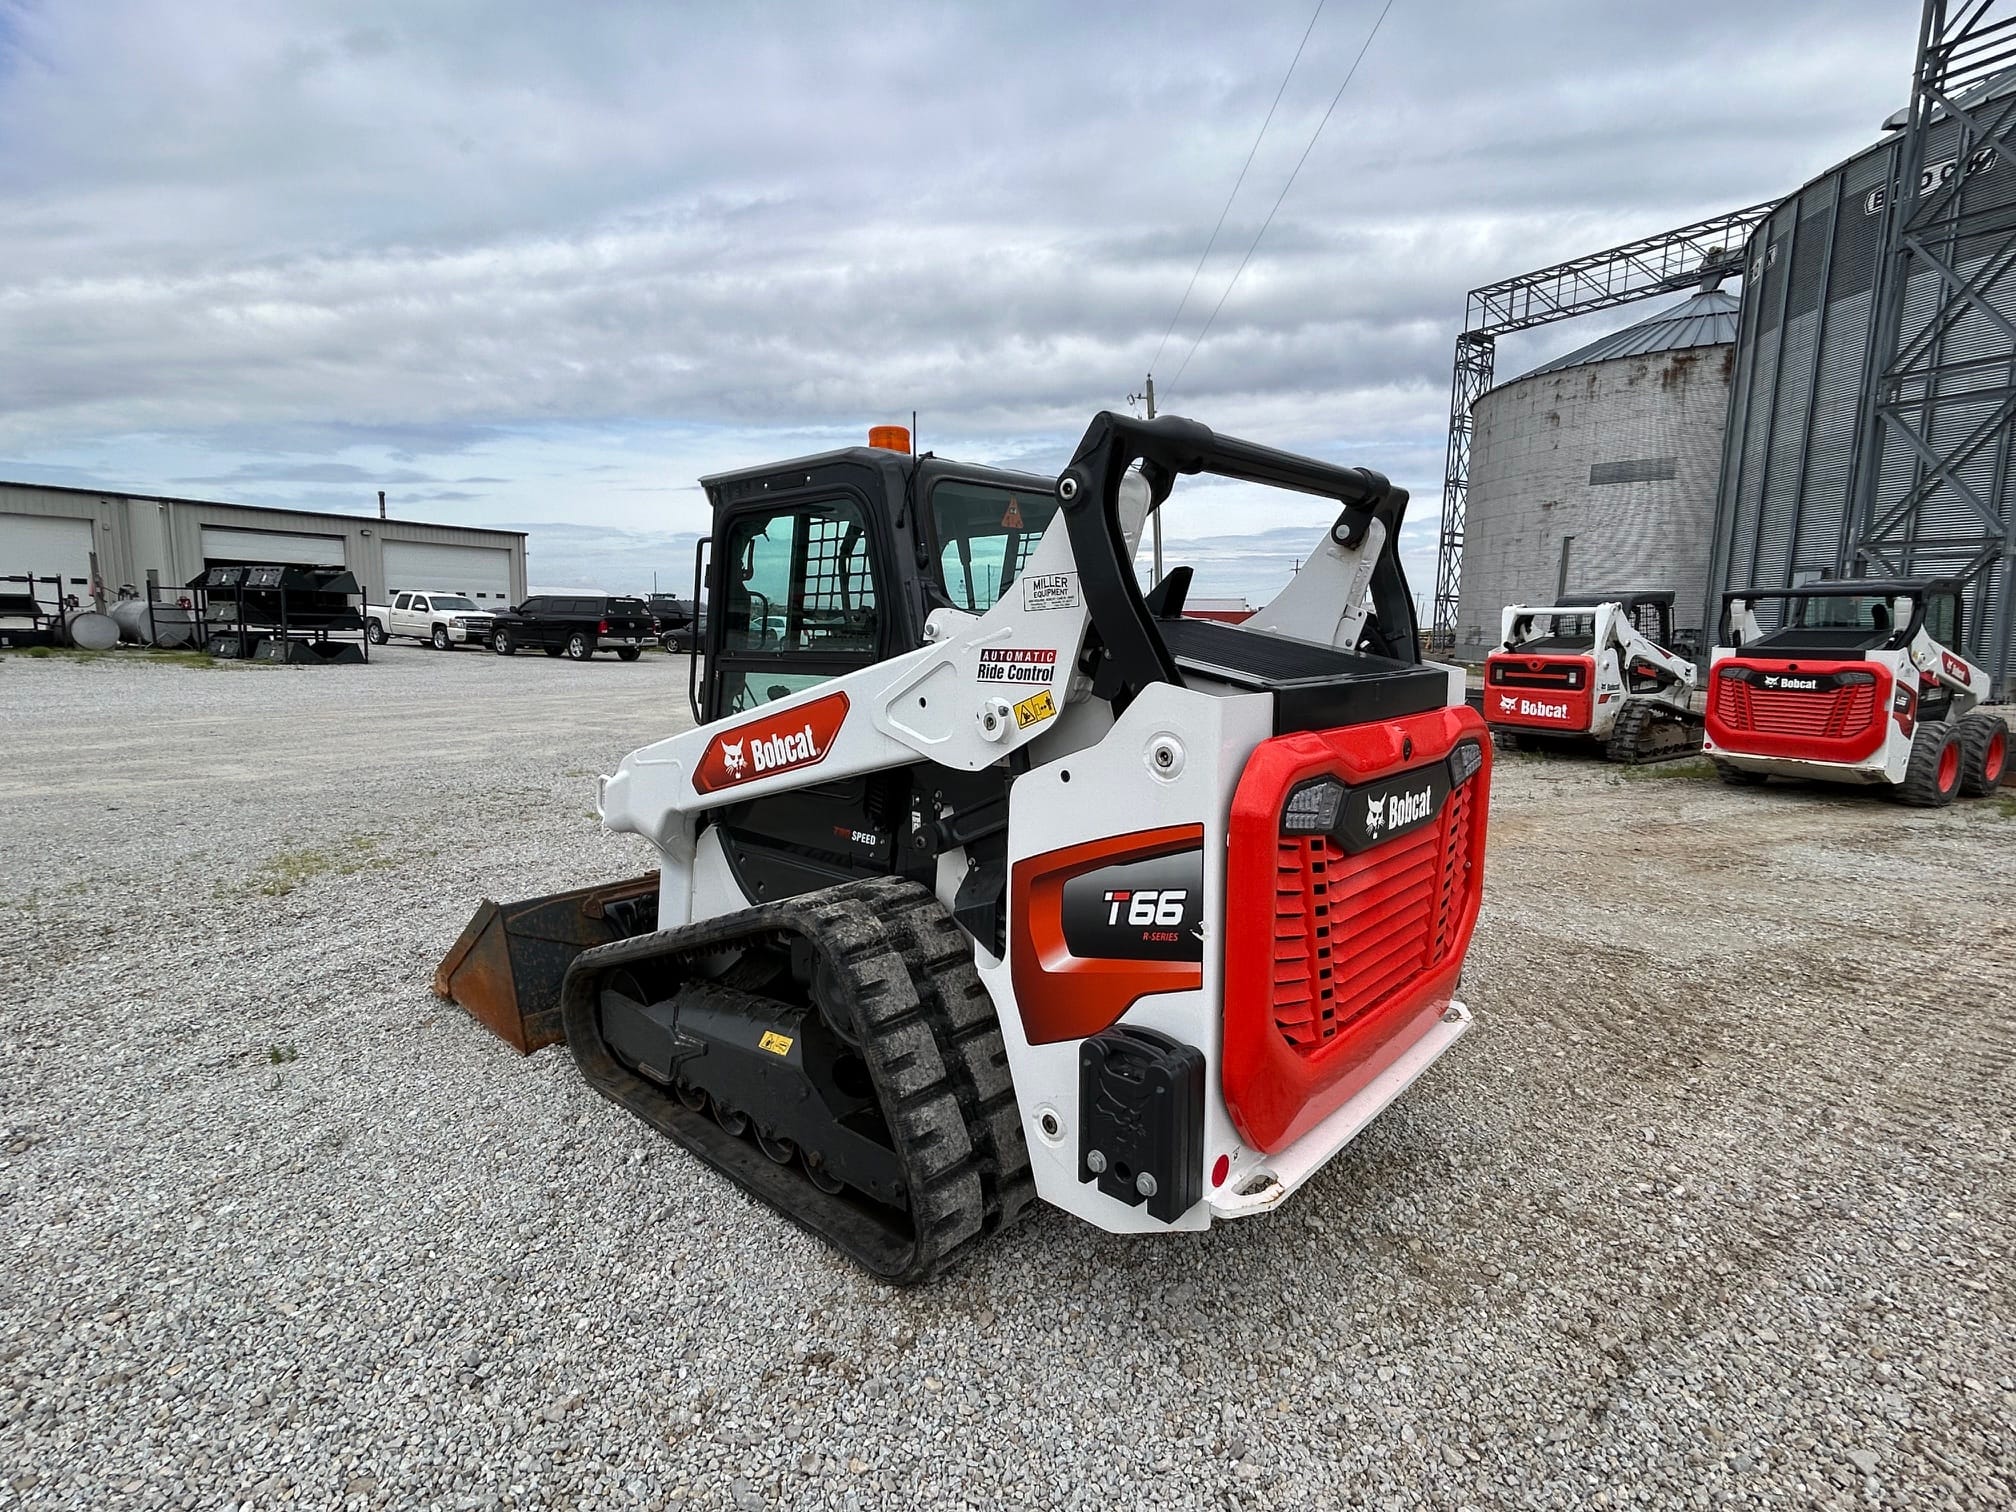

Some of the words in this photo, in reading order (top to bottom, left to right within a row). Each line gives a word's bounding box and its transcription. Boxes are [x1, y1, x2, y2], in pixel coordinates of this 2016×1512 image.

[1033, 576, 1068, 591] MILLER
[1033, 589, 1068, 598] EQUIPMENT
[982, 650, 1054, 662] AUTOMATIC
[977, 664, 1005, 679] Ride
[1007, 665, 1055, 682] Control
[1780, 678, 1817, 689] Bobcat
[1520, 700, 1568, 719] Bobcat
[750, 724, 817, 772] Bobcat
[1388, 784, 1432, 830] Bobcat
[851, 830, 876, 846] SPEED
[1104, 890, 1187, 926] T66
[1142, 932, 1179, 942] R-SERIES
